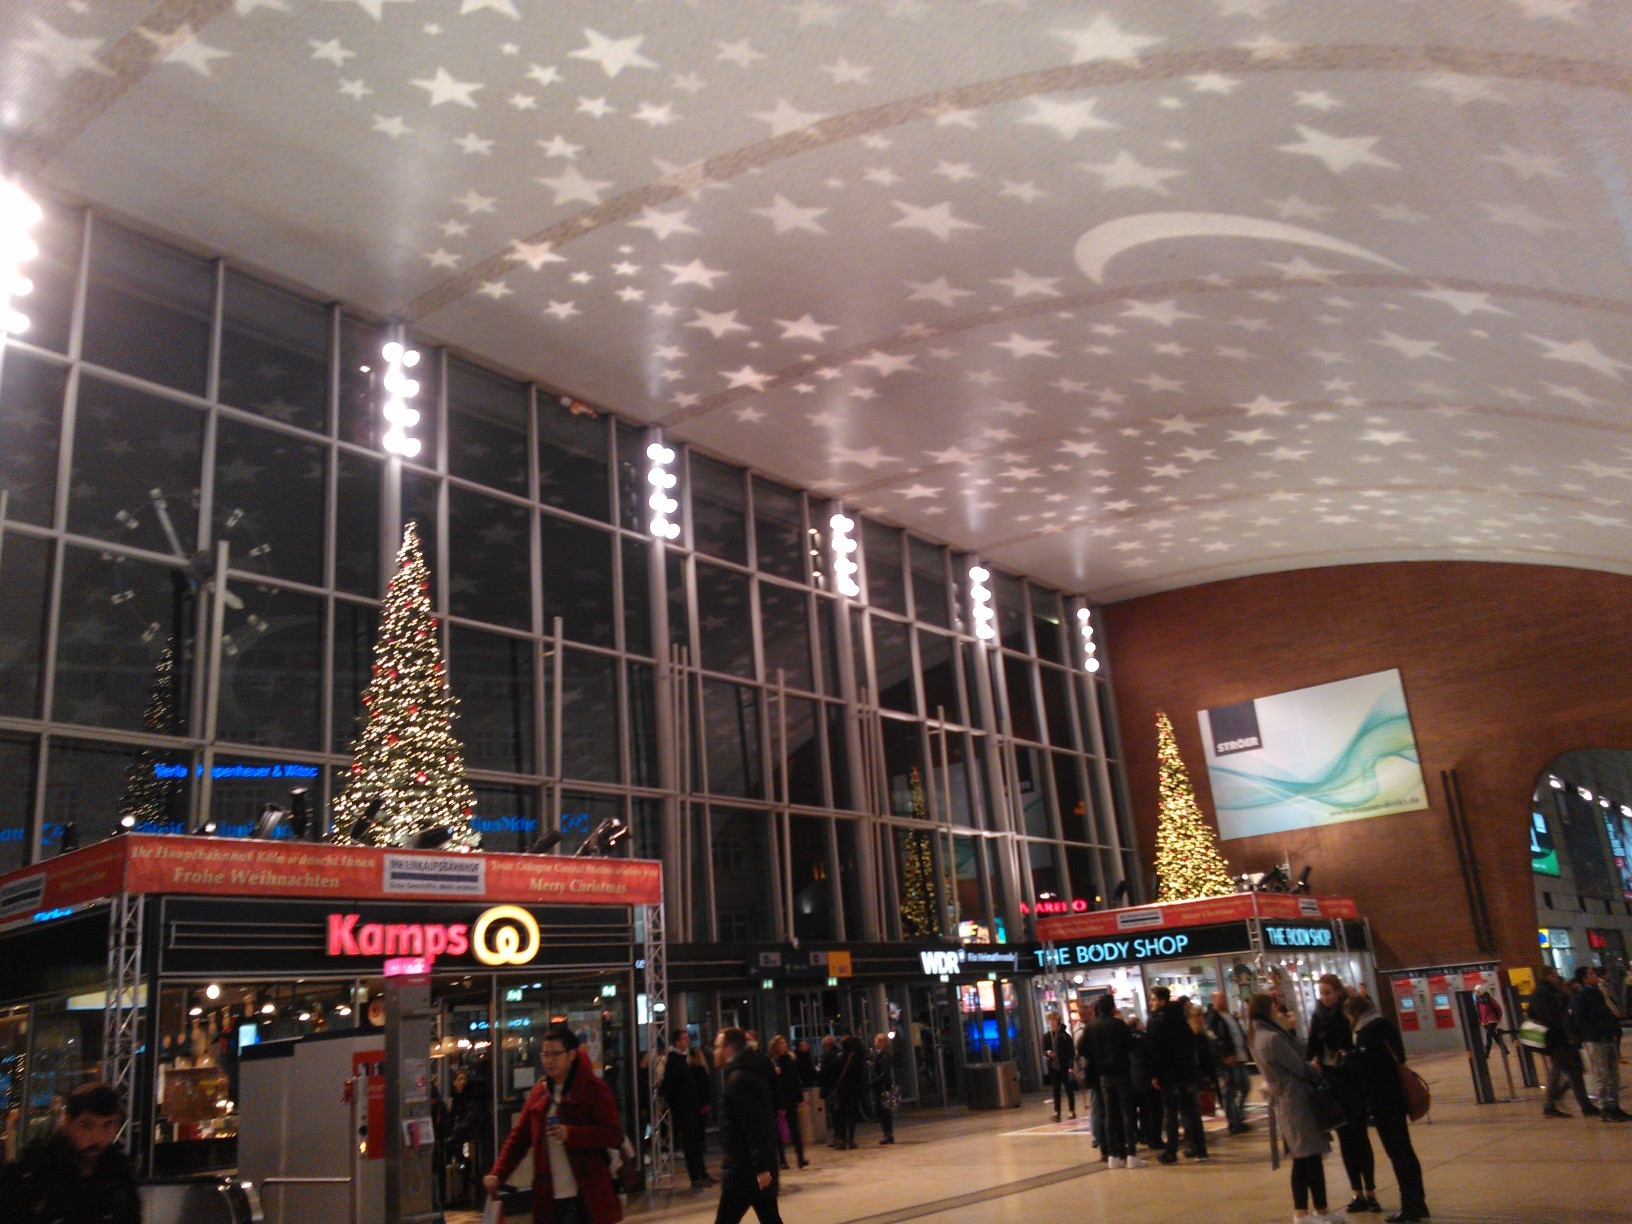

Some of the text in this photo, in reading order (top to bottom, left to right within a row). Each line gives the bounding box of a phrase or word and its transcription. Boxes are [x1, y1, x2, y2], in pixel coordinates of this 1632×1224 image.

[155, 846, 254, 862] Hauptbahnhof
[173, 866, 341, 889] Frohe Weihnachten
[529, 877, 628, 895] Merry Christmas
[327, 913, 469, 964] Kamps
[1265, 927, 1287, 945] THE
[1309, 928, 1332, 946] SHOP
[1033, 947, 1071, 967] THE
[1076, 941, 1130, 964] BODY
[1133, 934, 1189, 958] SHOP
[920, 950, 961, 975] WDR
